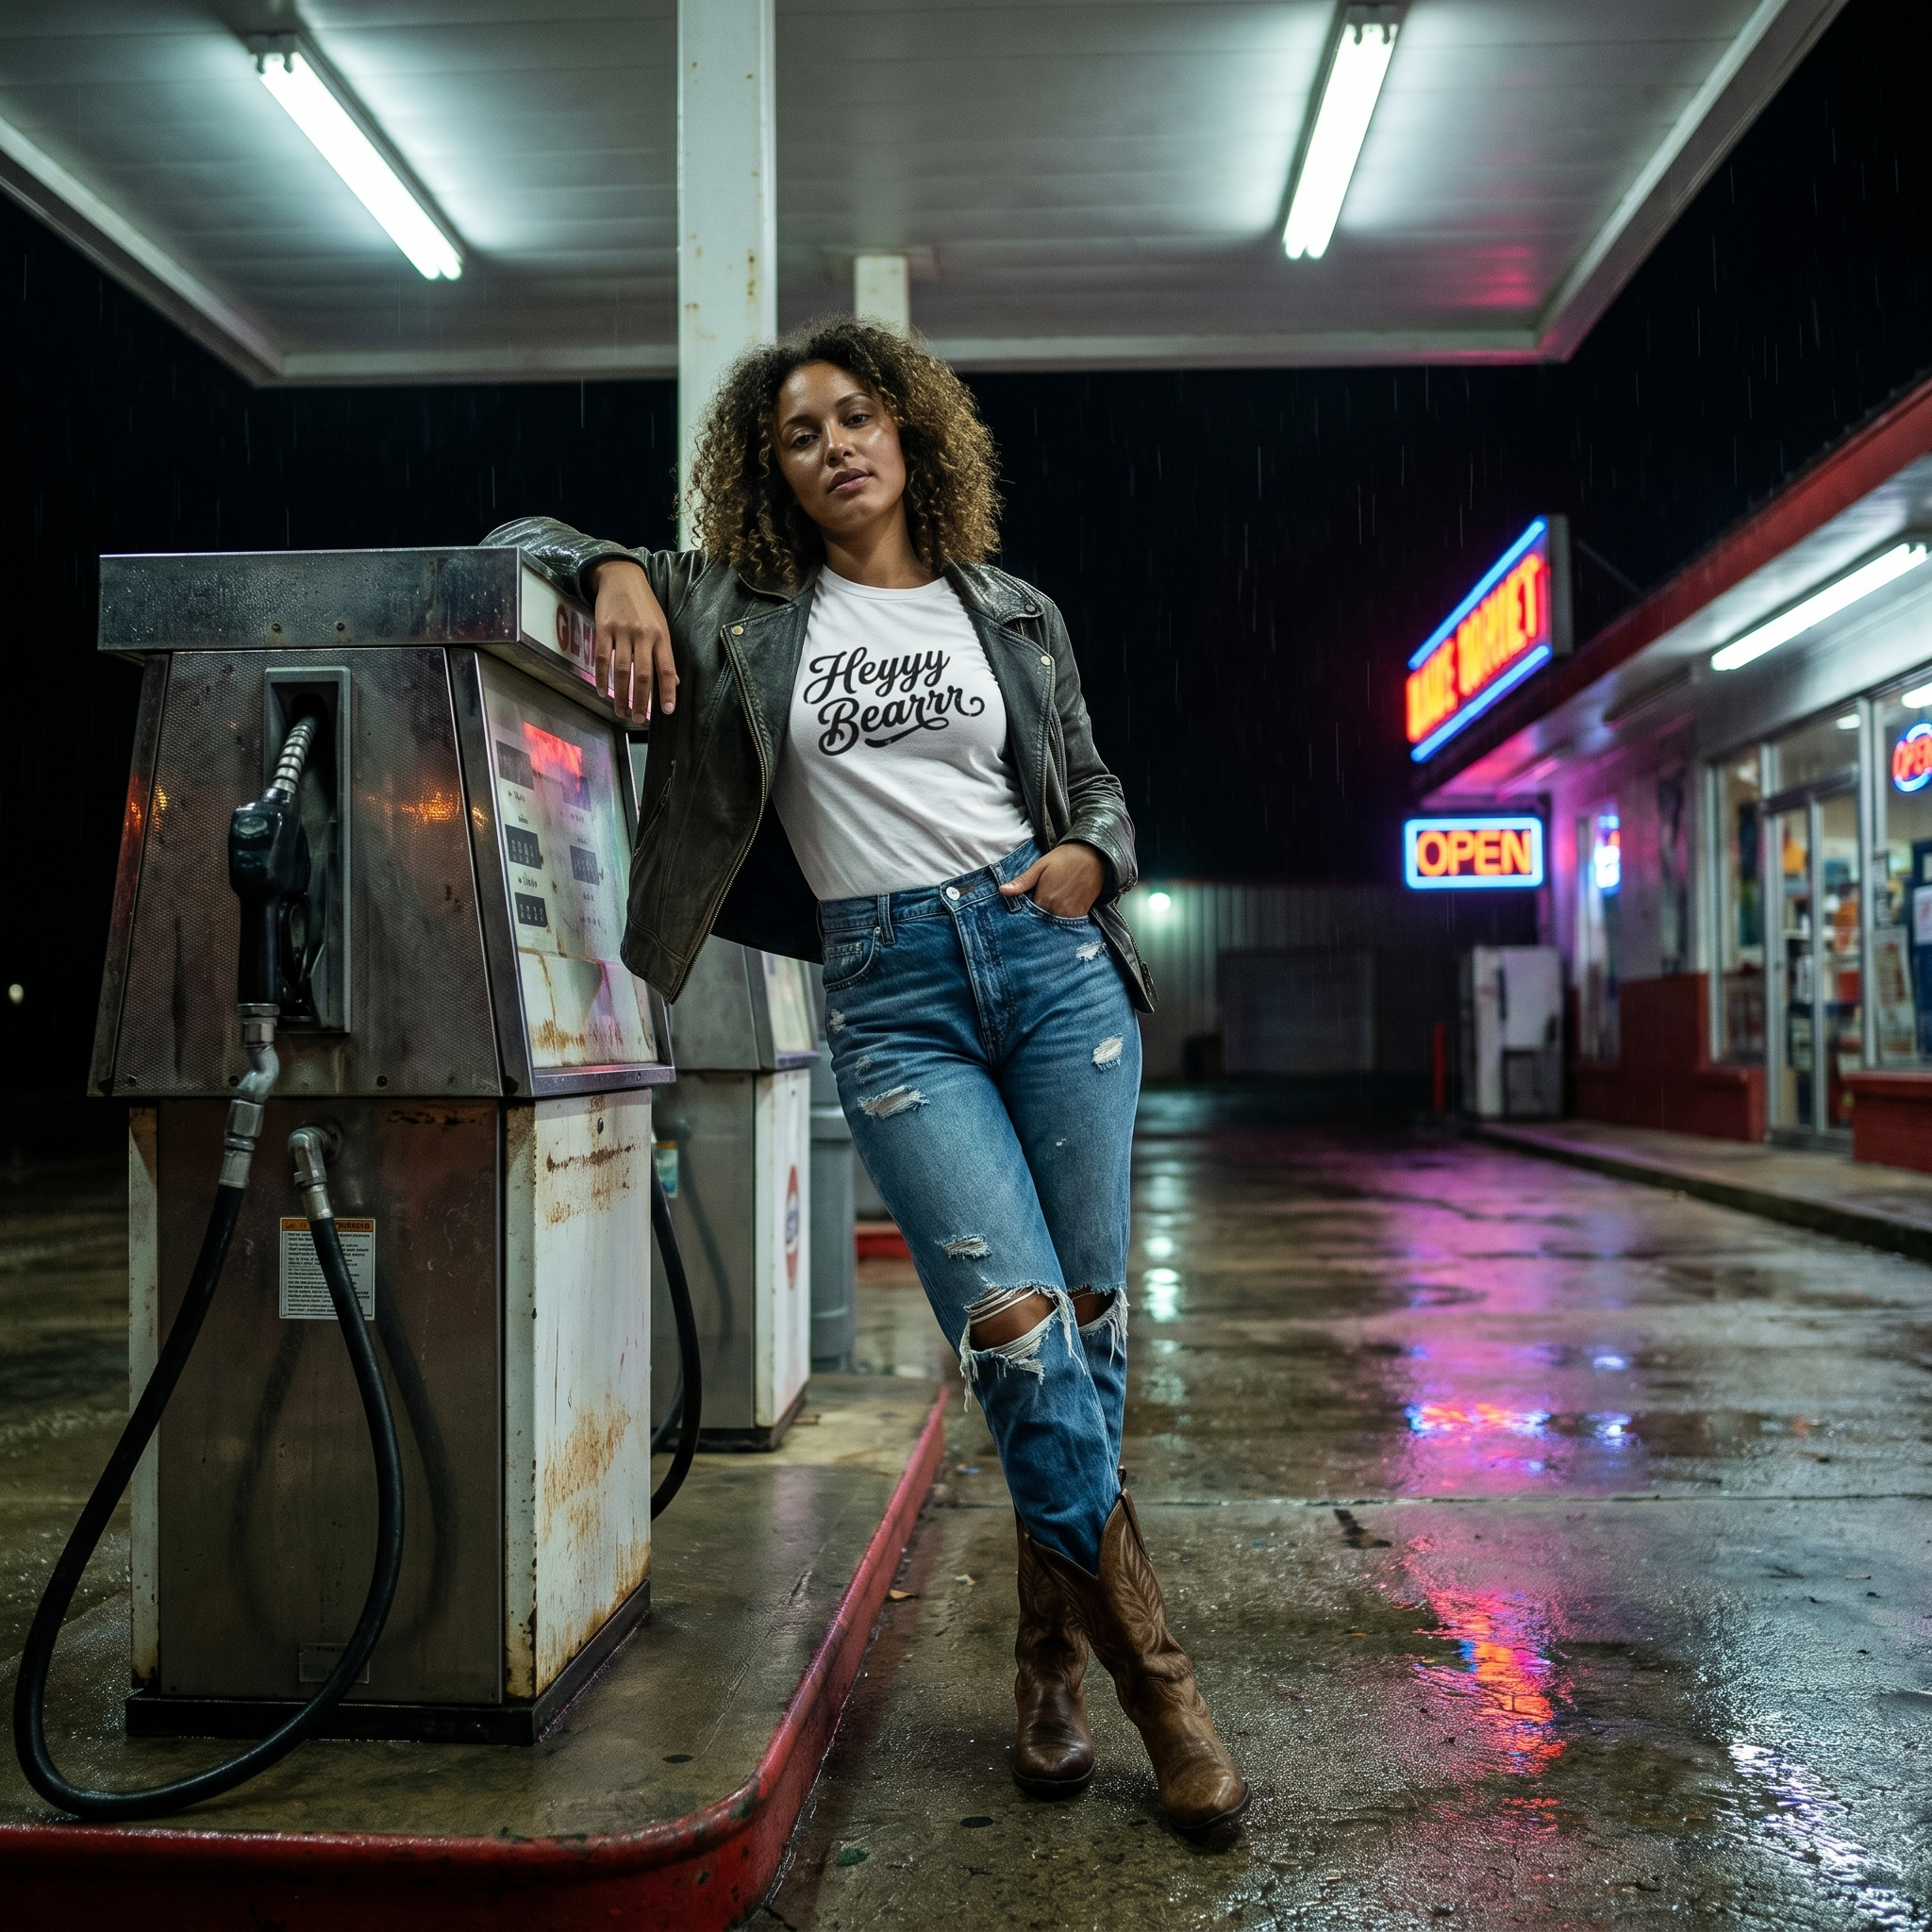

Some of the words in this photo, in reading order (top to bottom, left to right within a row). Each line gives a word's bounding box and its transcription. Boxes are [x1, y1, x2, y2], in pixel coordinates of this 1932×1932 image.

[803, 646, 951, 705] Heyyy
[817, 685, 986, 757] Bearrr
[1416, 828, 1533, 877] OPEN
